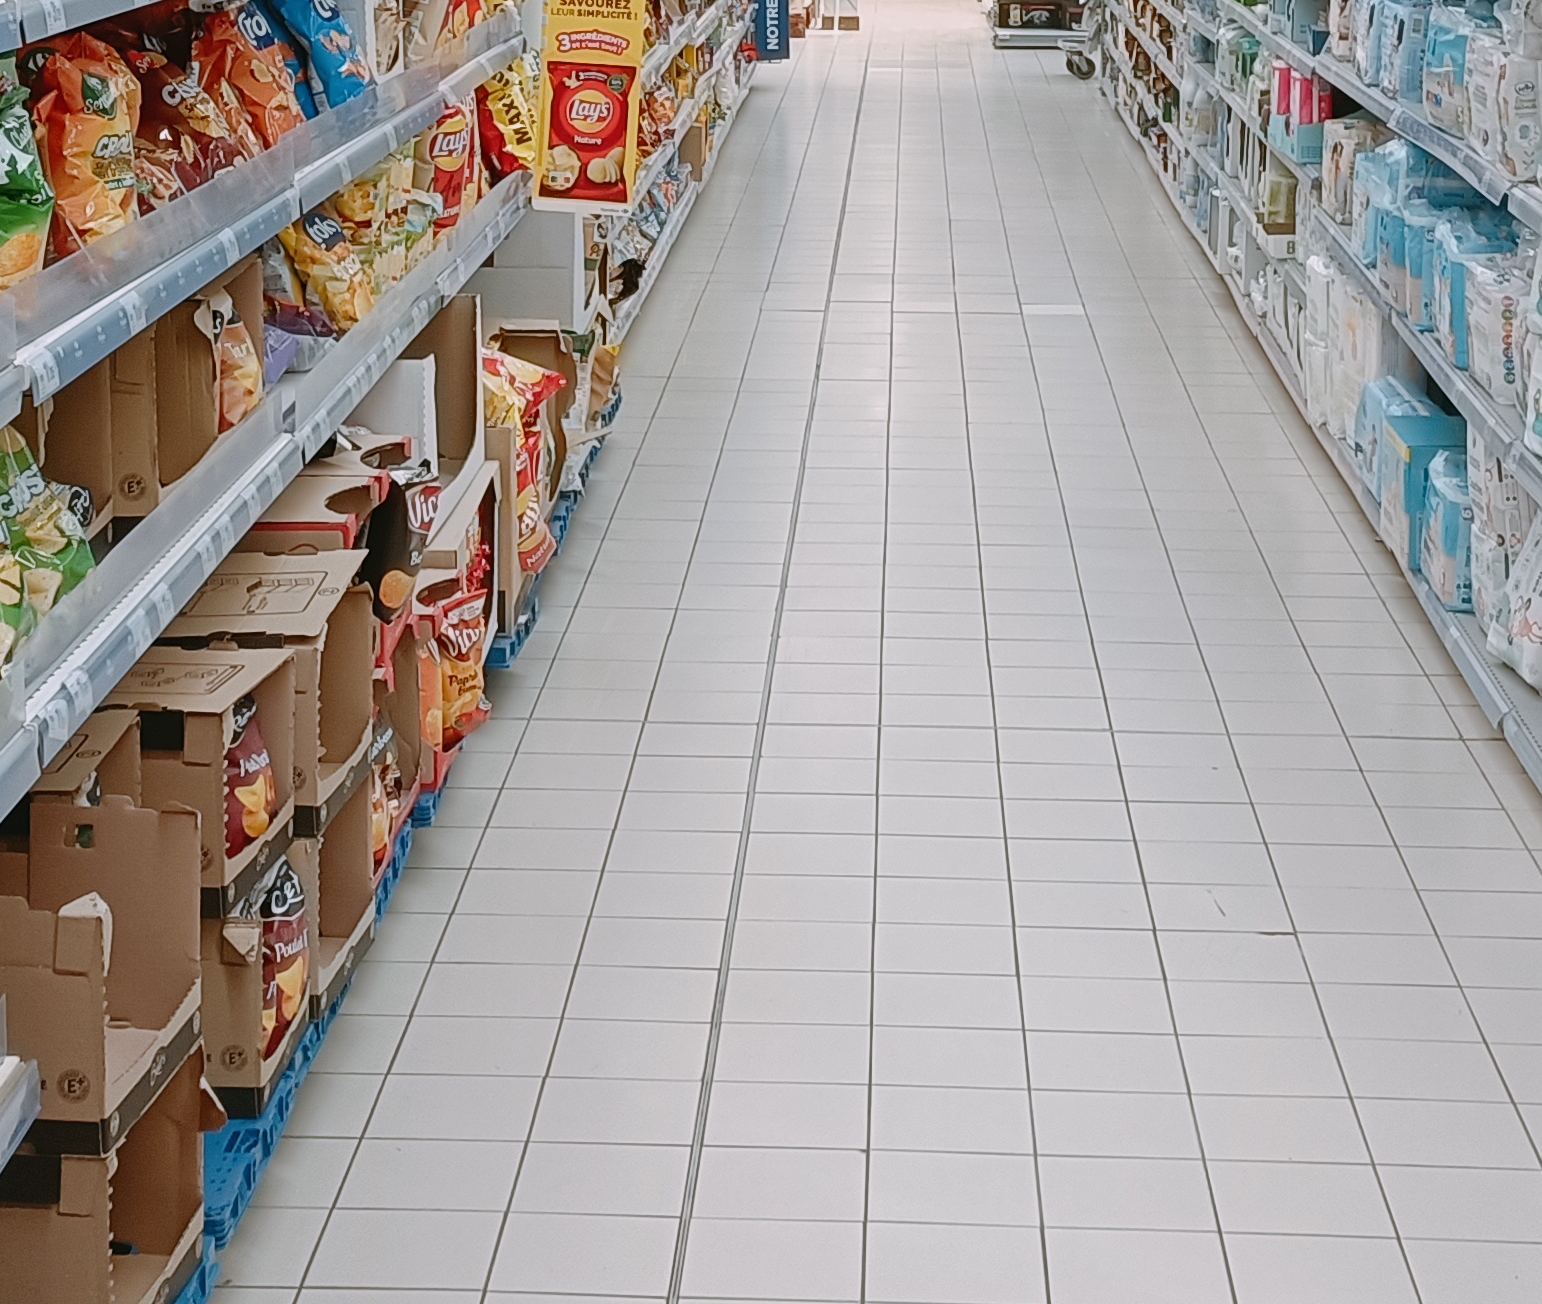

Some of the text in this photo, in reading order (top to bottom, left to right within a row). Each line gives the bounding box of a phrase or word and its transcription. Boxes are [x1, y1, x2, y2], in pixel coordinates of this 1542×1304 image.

[551, 8, 575, 16] LEUR
[558, 35, 571, 51] 3
[570, 99, 610, 123] Lay's
[574, 135, 602, 145] Nature
